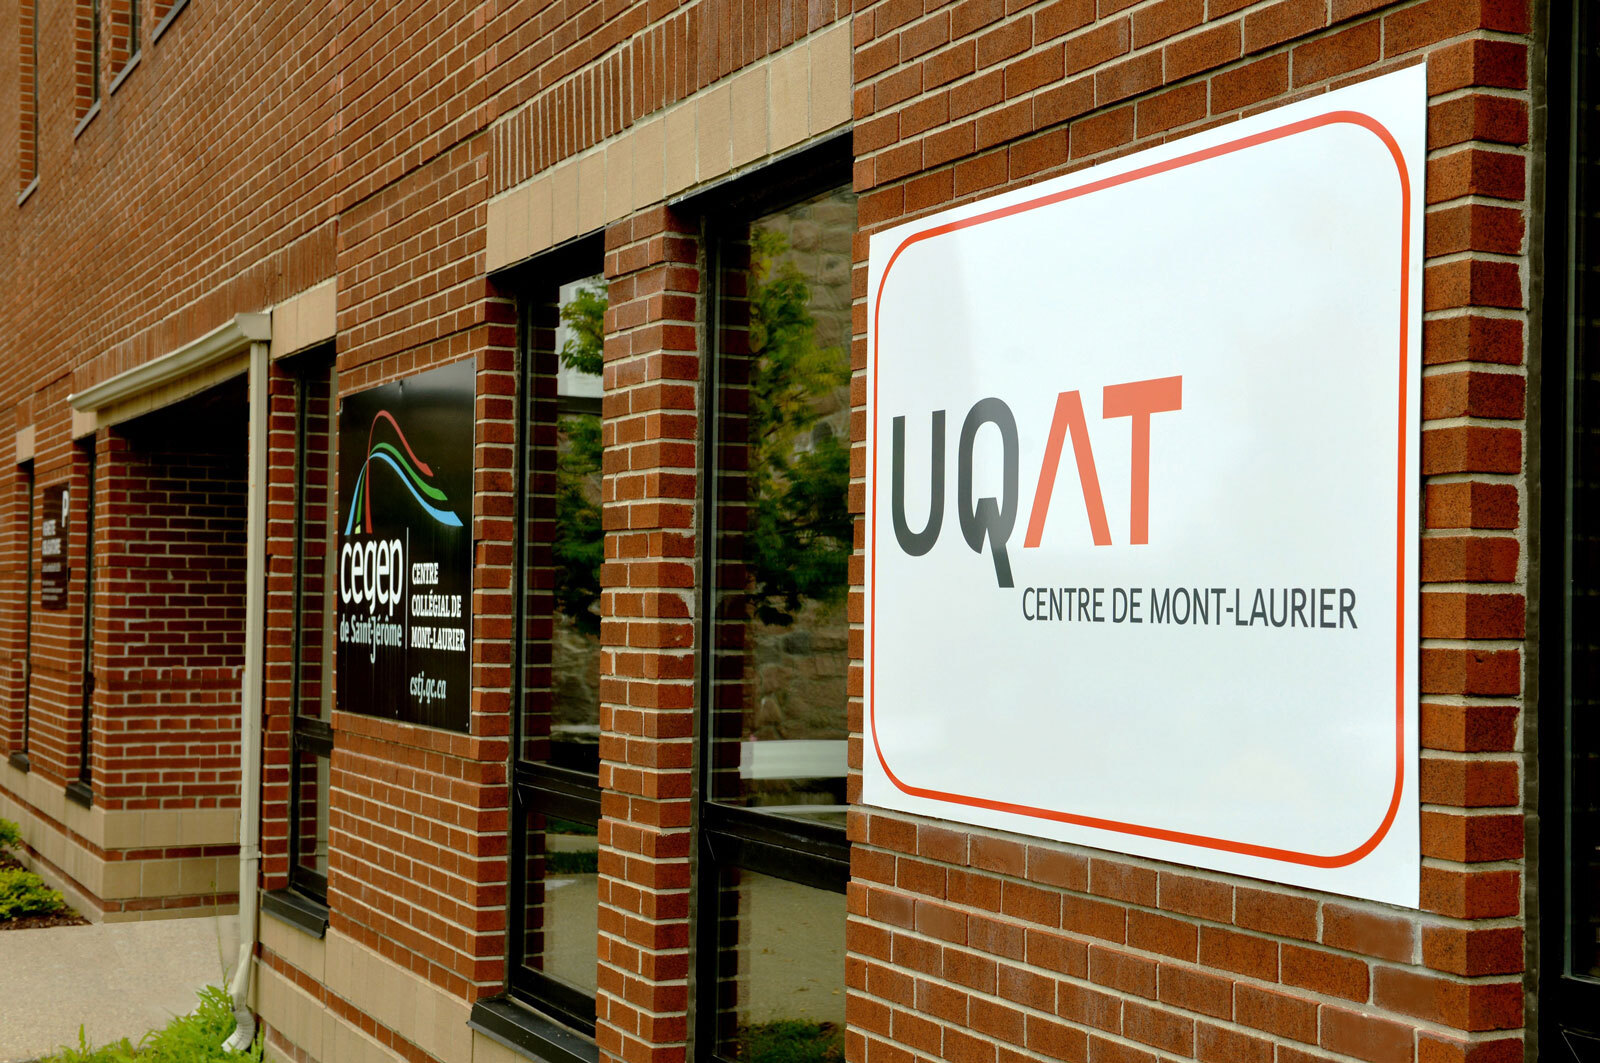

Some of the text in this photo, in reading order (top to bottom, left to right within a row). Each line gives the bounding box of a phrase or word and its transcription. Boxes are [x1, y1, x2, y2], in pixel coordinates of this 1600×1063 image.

[892, 375, 1183, 588] UQAT
[412, 562, 439, 585] CENTRE
[411, 589, 462, 618] COLLÉGIAL DE
[1022, 587, 1359, 629] CENTRE DE MONT-LAURIER
[340, 613, 403, 663] de Saint-Jérôme
[411, 626, 466, 652] MONT-LAURIER
[409, 671, 447, 704] cstj.qc.ca
